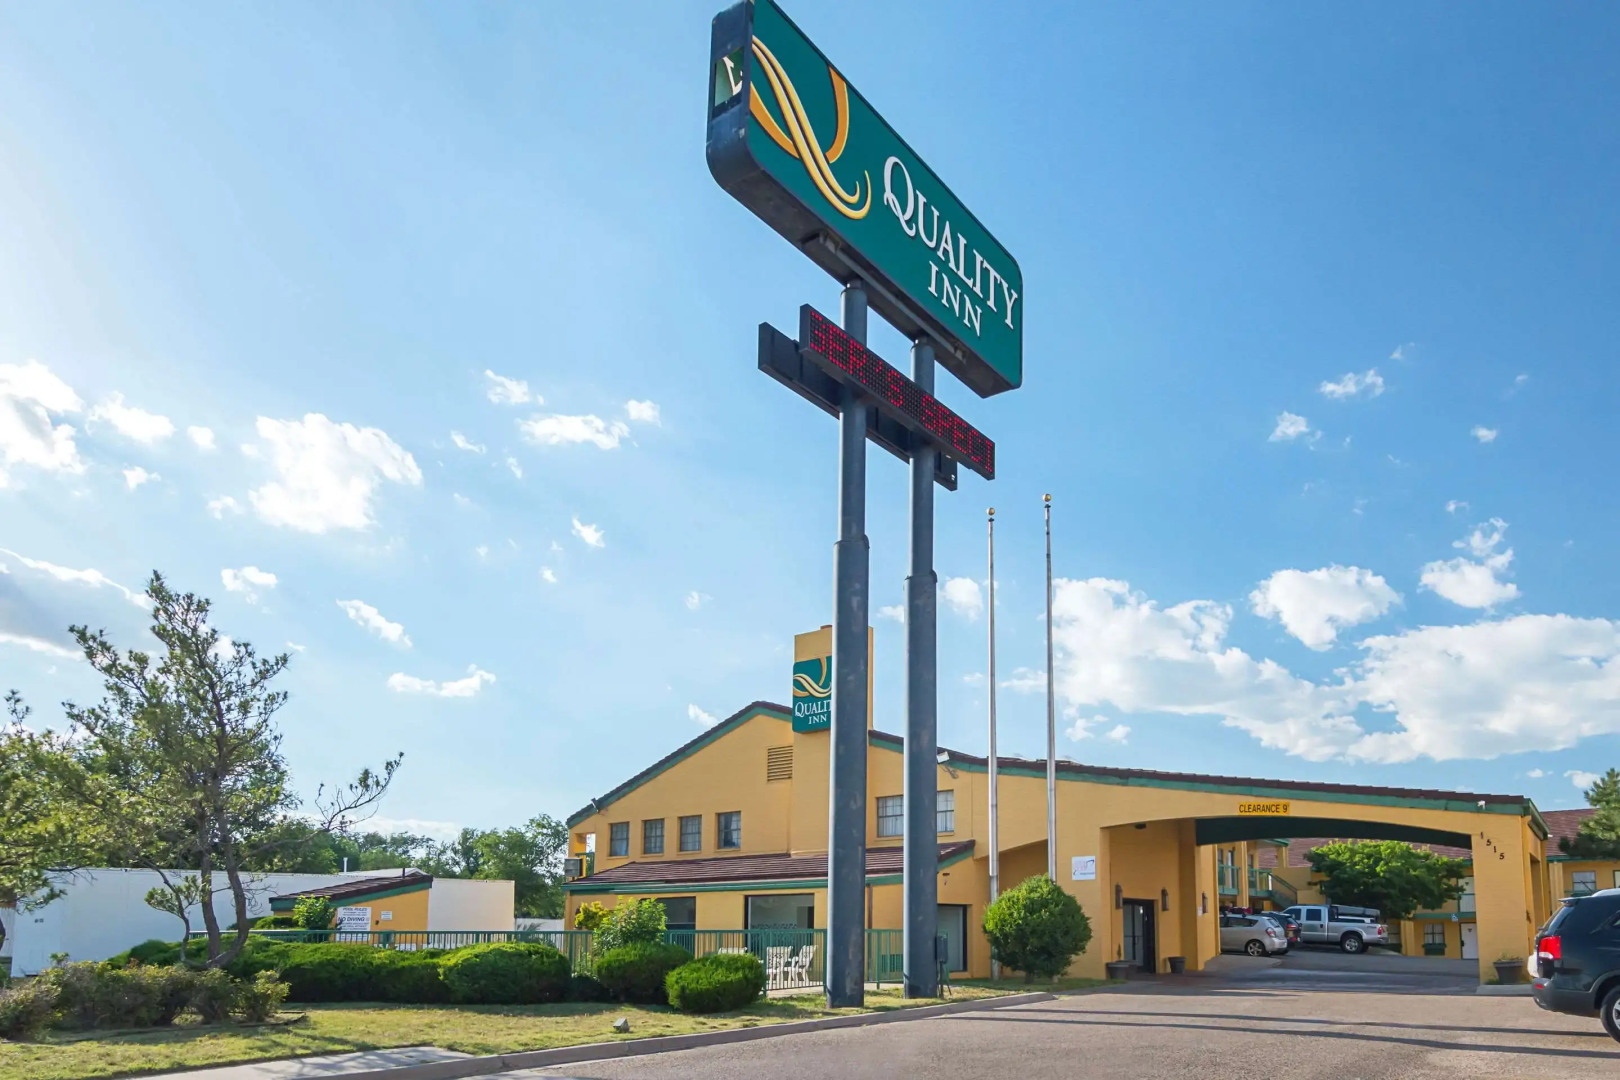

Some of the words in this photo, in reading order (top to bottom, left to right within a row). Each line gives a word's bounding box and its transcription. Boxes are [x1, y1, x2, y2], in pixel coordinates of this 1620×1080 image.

[884, 156, 1018, 330] QUALITY
[928, 260, 982, 337] INN
[808, 714, 827, 724] INN
[1239, 804, 1280, 813] CLEARANCE
